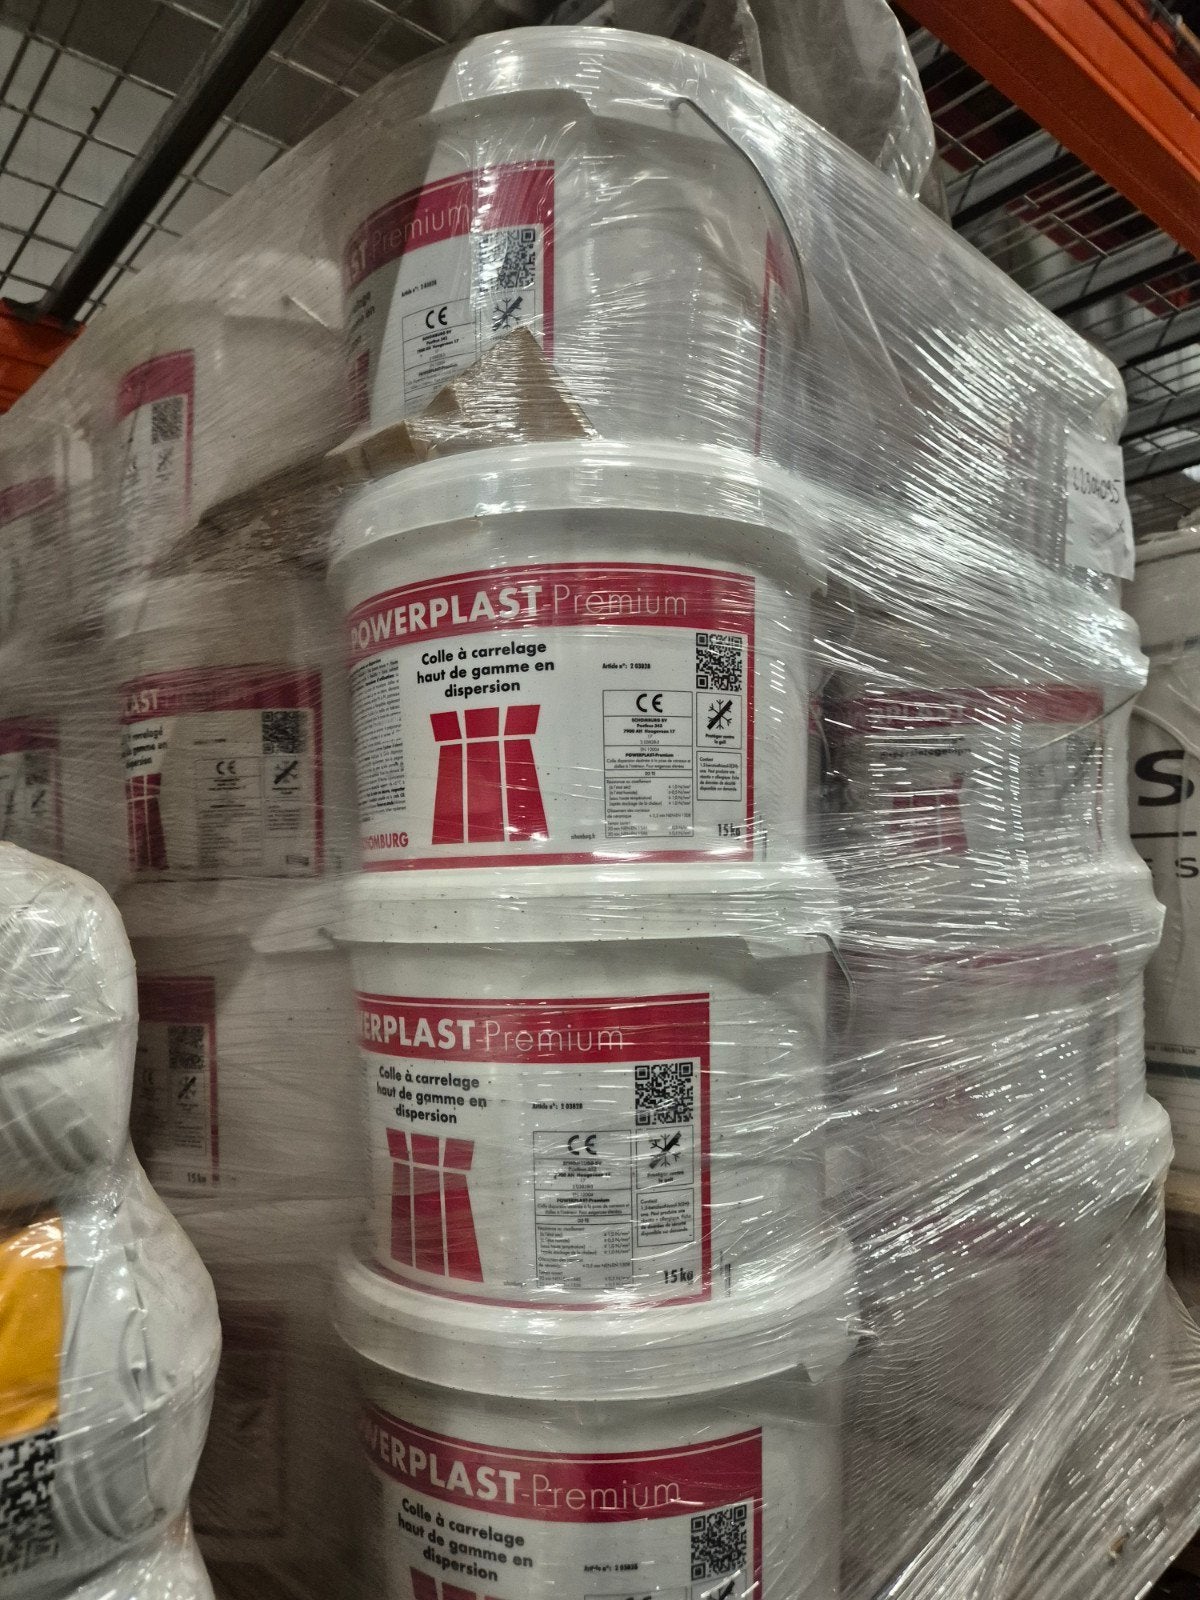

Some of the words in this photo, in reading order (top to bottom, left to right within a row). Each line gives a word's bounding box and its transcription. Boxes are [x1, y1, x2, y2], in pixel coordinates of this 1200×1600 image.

[422, 649, 453, 665] Colle
[458, 647, 467, 660] à
[471, 641, 547, 658] carrelage
[417, 671, 445, 684] haut
[450, 666, 467, 679] de
[472, 662, 530, 679] gamme
[535, 661, 555, 671] en
[445, 680, 520, 699] dispersion
[636, 693, 663, 713] CE
[1135, 750, 1195, 807] S
[717, 824, 729, 836] 15
[379, 1065, 402, 1081] Colle
[405, 1069, 413, 1083] à
[416, 1073, 480, 1091] carrelage
[377, 1082, 396, 1098] haut
[398, 1087, 413, 1100] de
[416, 1092, 464, 1106] gamme
[469, 1096, 487, 1108] en
[395, 1104, 457, 1124] dispersion
[402, 1498, 432, 1523] Colle
[436, 1512, 445, 1527] à
[449, 1519, 525, 1548] carrelage
[398, 1512, 425, 1538] haut
[428, 1529, 445, 1547] de
[449, 1538, 507, 1563] gamme
[513, 1555, 533, 1568] en
[423, 1546, 498, 1581] dispersion
